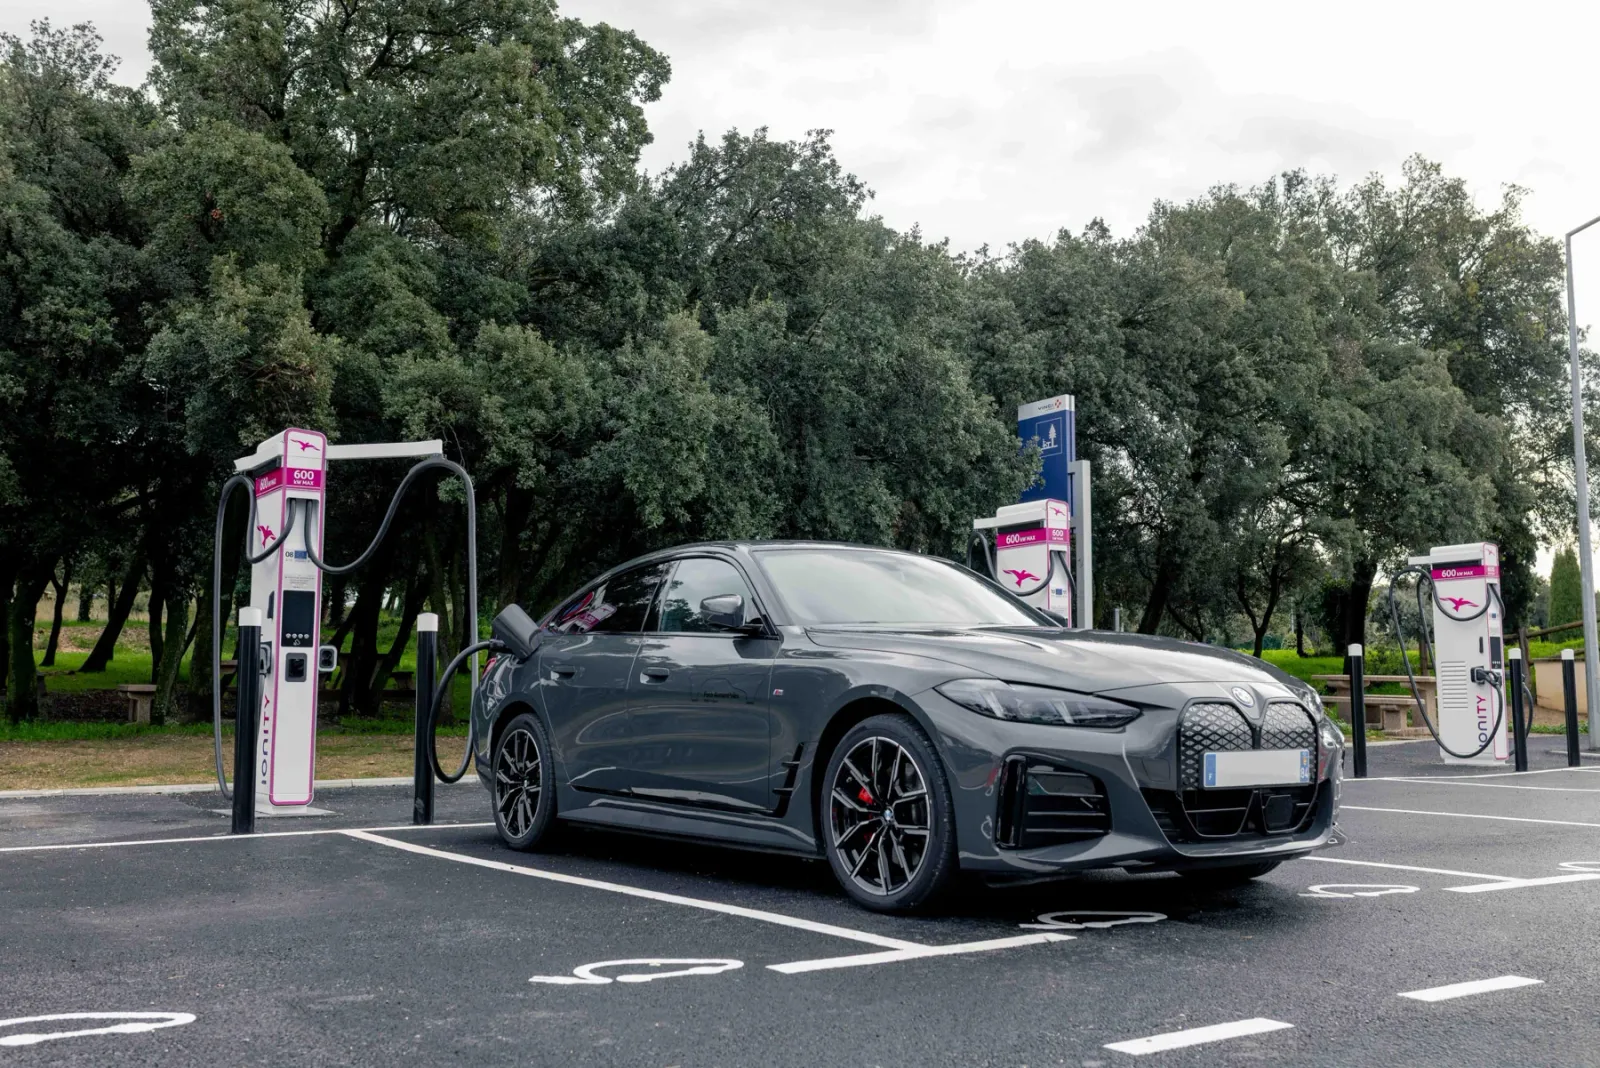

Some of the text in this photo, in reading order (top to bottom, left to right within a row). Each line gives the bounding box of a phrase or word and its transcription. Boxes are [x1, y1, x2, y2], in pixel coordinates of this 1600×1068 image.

[294, 470, 314, 480] 600
[1006, 534, 1020, 545] 600
[1441, 569, 1456, 577] 600
[261, 695, 270, 785] IONITY
